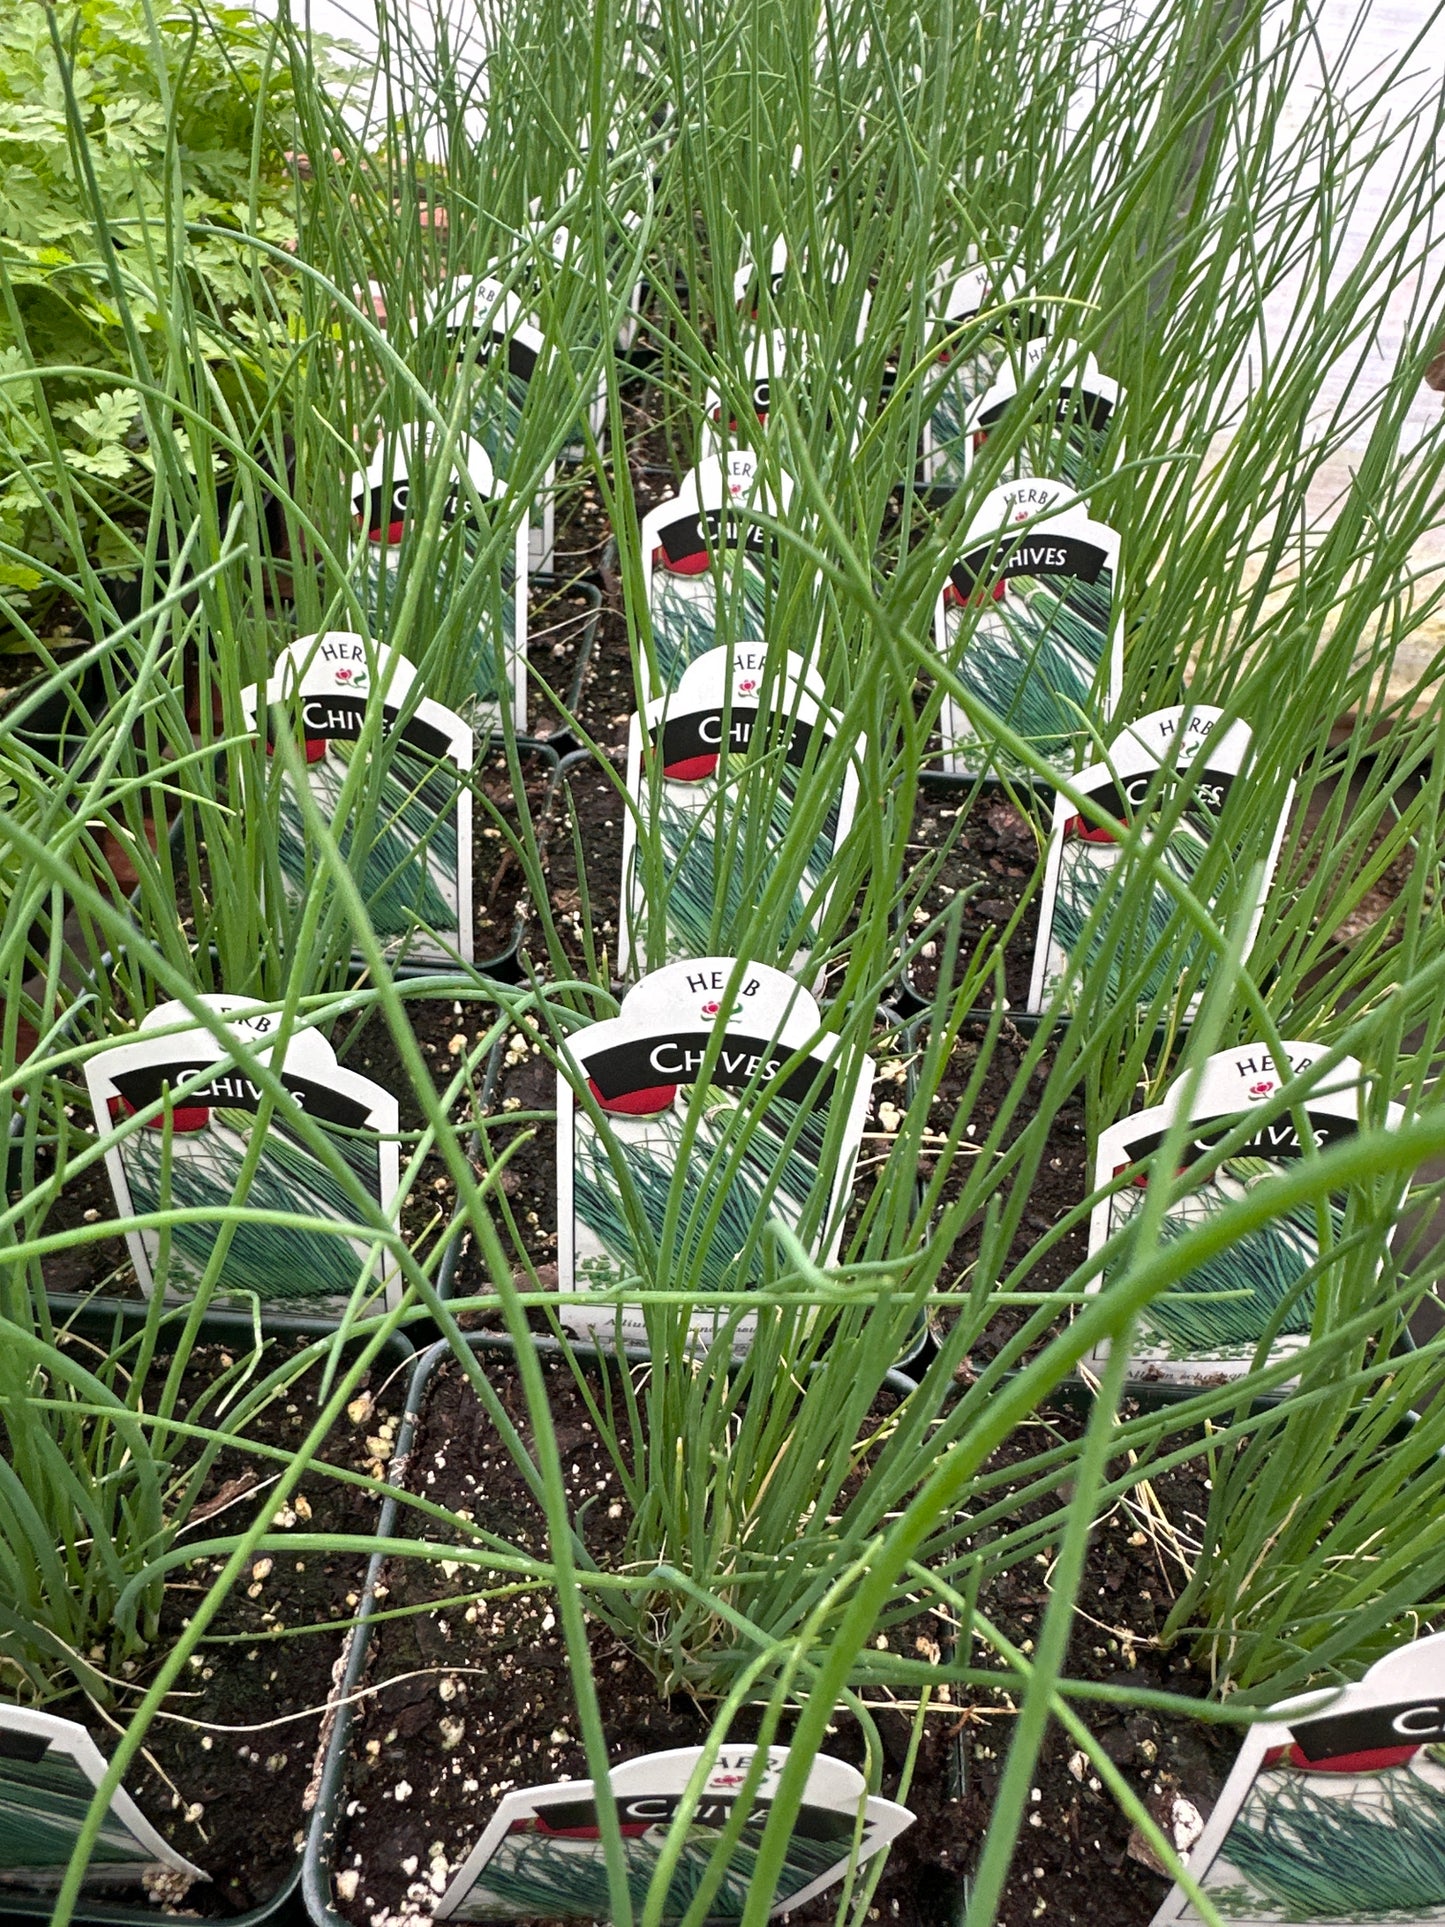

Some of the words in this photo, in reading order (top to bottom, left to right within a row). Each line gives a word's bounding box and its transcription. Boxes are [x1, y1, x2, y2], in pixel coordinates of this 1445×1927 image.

[1004, 488, 1048, 505] HERB
[320, 643, 368, 665] HER
[698, 716, 797, 750] CHIS
[1159, 716, 1214, 737] HRB
[1126, 779, 1224, 806] CHIES
[685, 970, 761, 997] HEB
[649, 1042, 782, 1082] CHVES
[175, 1068, 307, 1111] CHIVS
[626, 1798, 771, 1823] CIE
